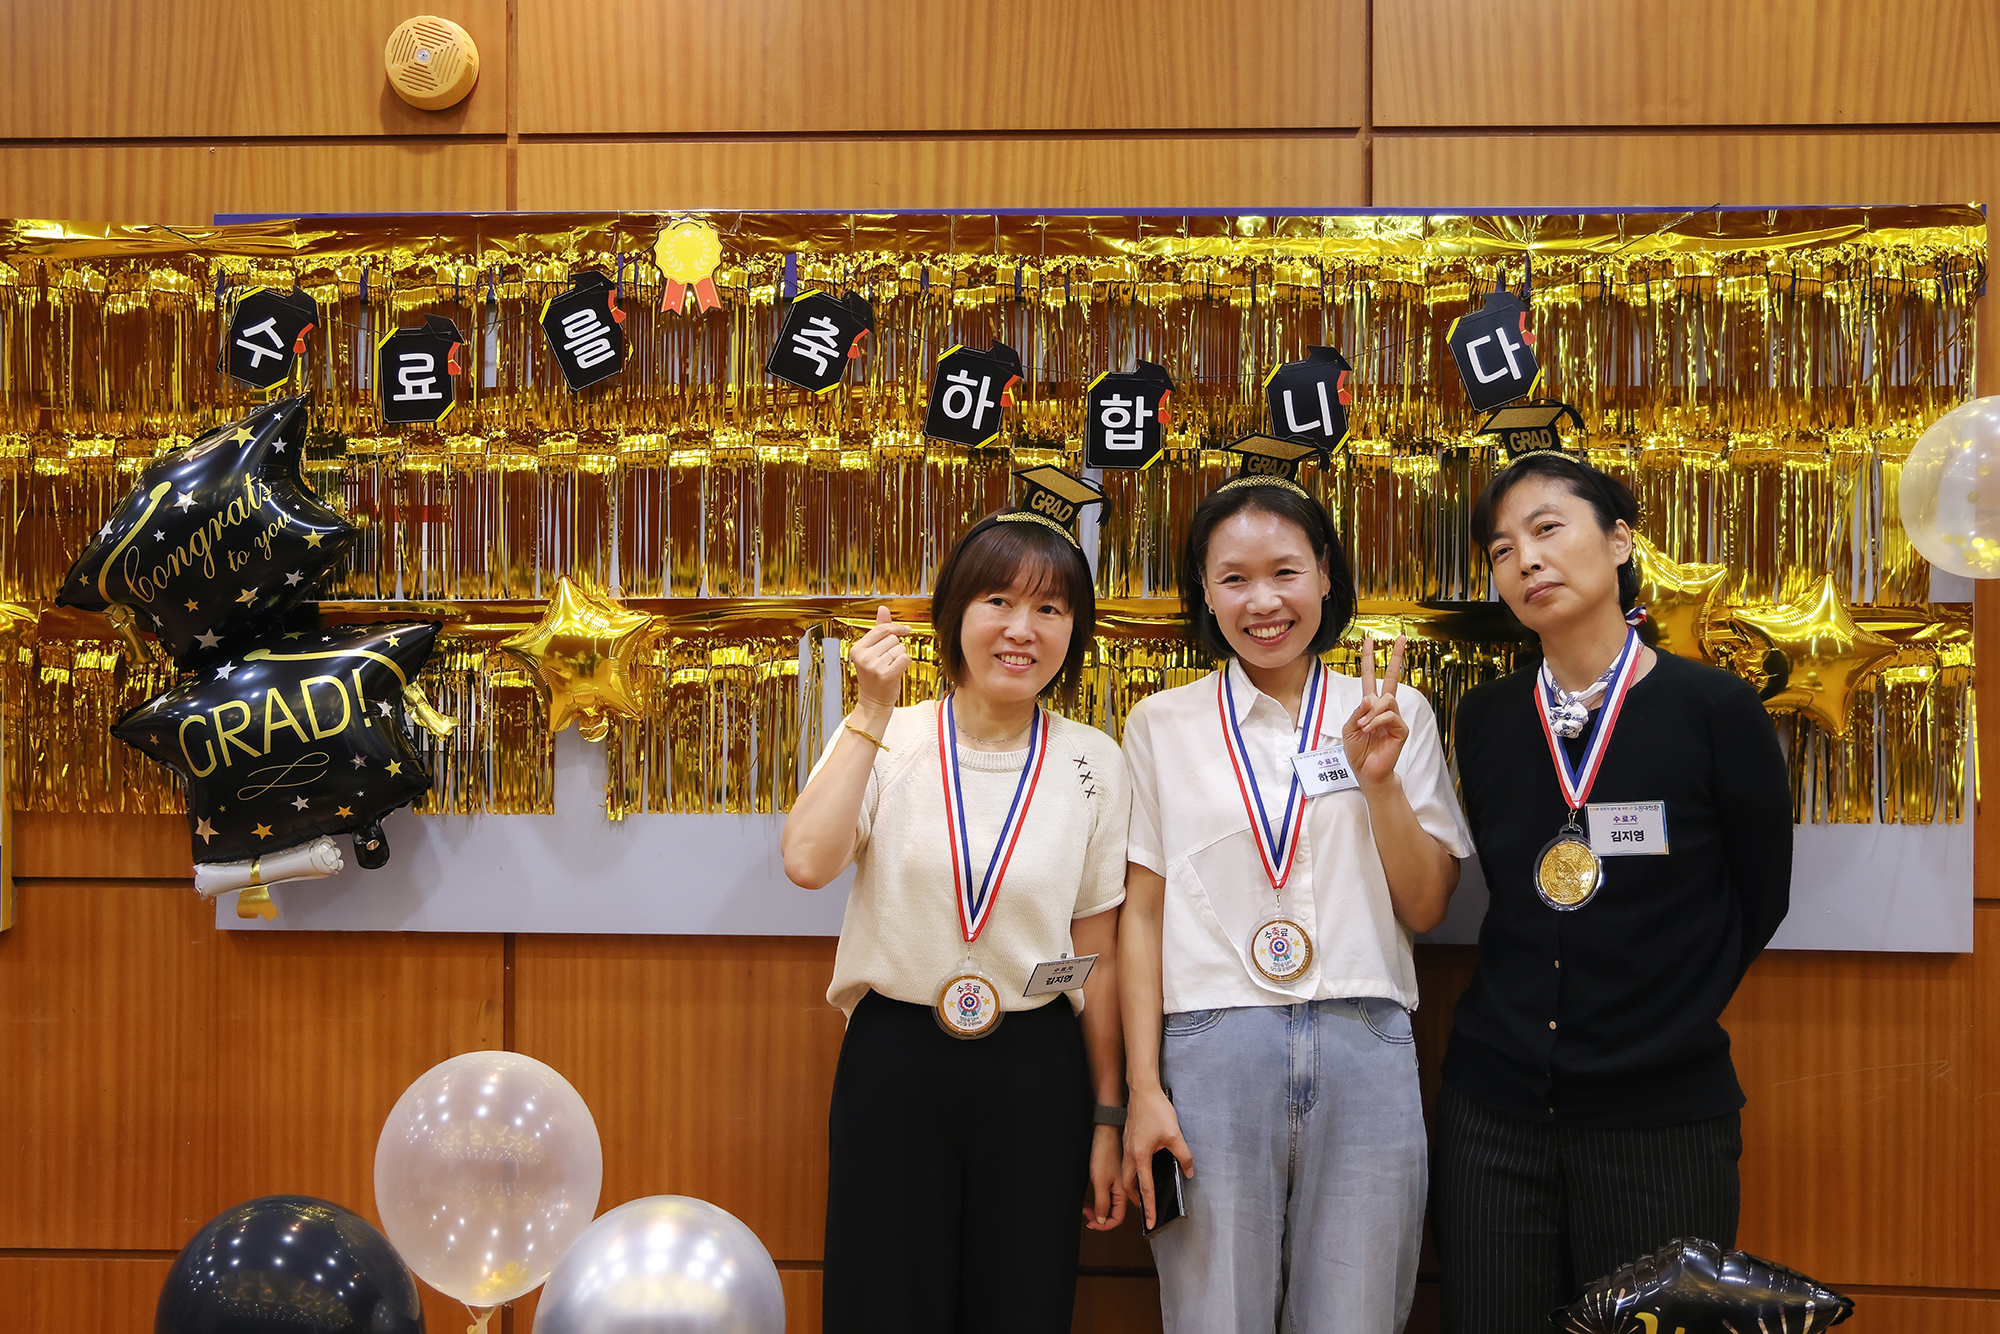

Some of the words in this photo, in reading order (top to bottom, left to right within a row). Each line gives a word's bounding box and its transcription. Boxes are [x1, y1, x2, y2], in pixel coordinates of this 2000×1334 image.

[1509, 429, 1553, 452] GRAD
[1247, 455, 1291, 478] GRAD
[1030, 490, 1074, 522] GRAD
[124, 472, 273, 603] Congrats
[227, 550, 250, 572] to
[254, 510, 292, 561] you
[178, 668, 372, 778] GRAD!
[1317, 768, 1349, 782] 하경임
[1610, 830, 1645, 842] 김지영
